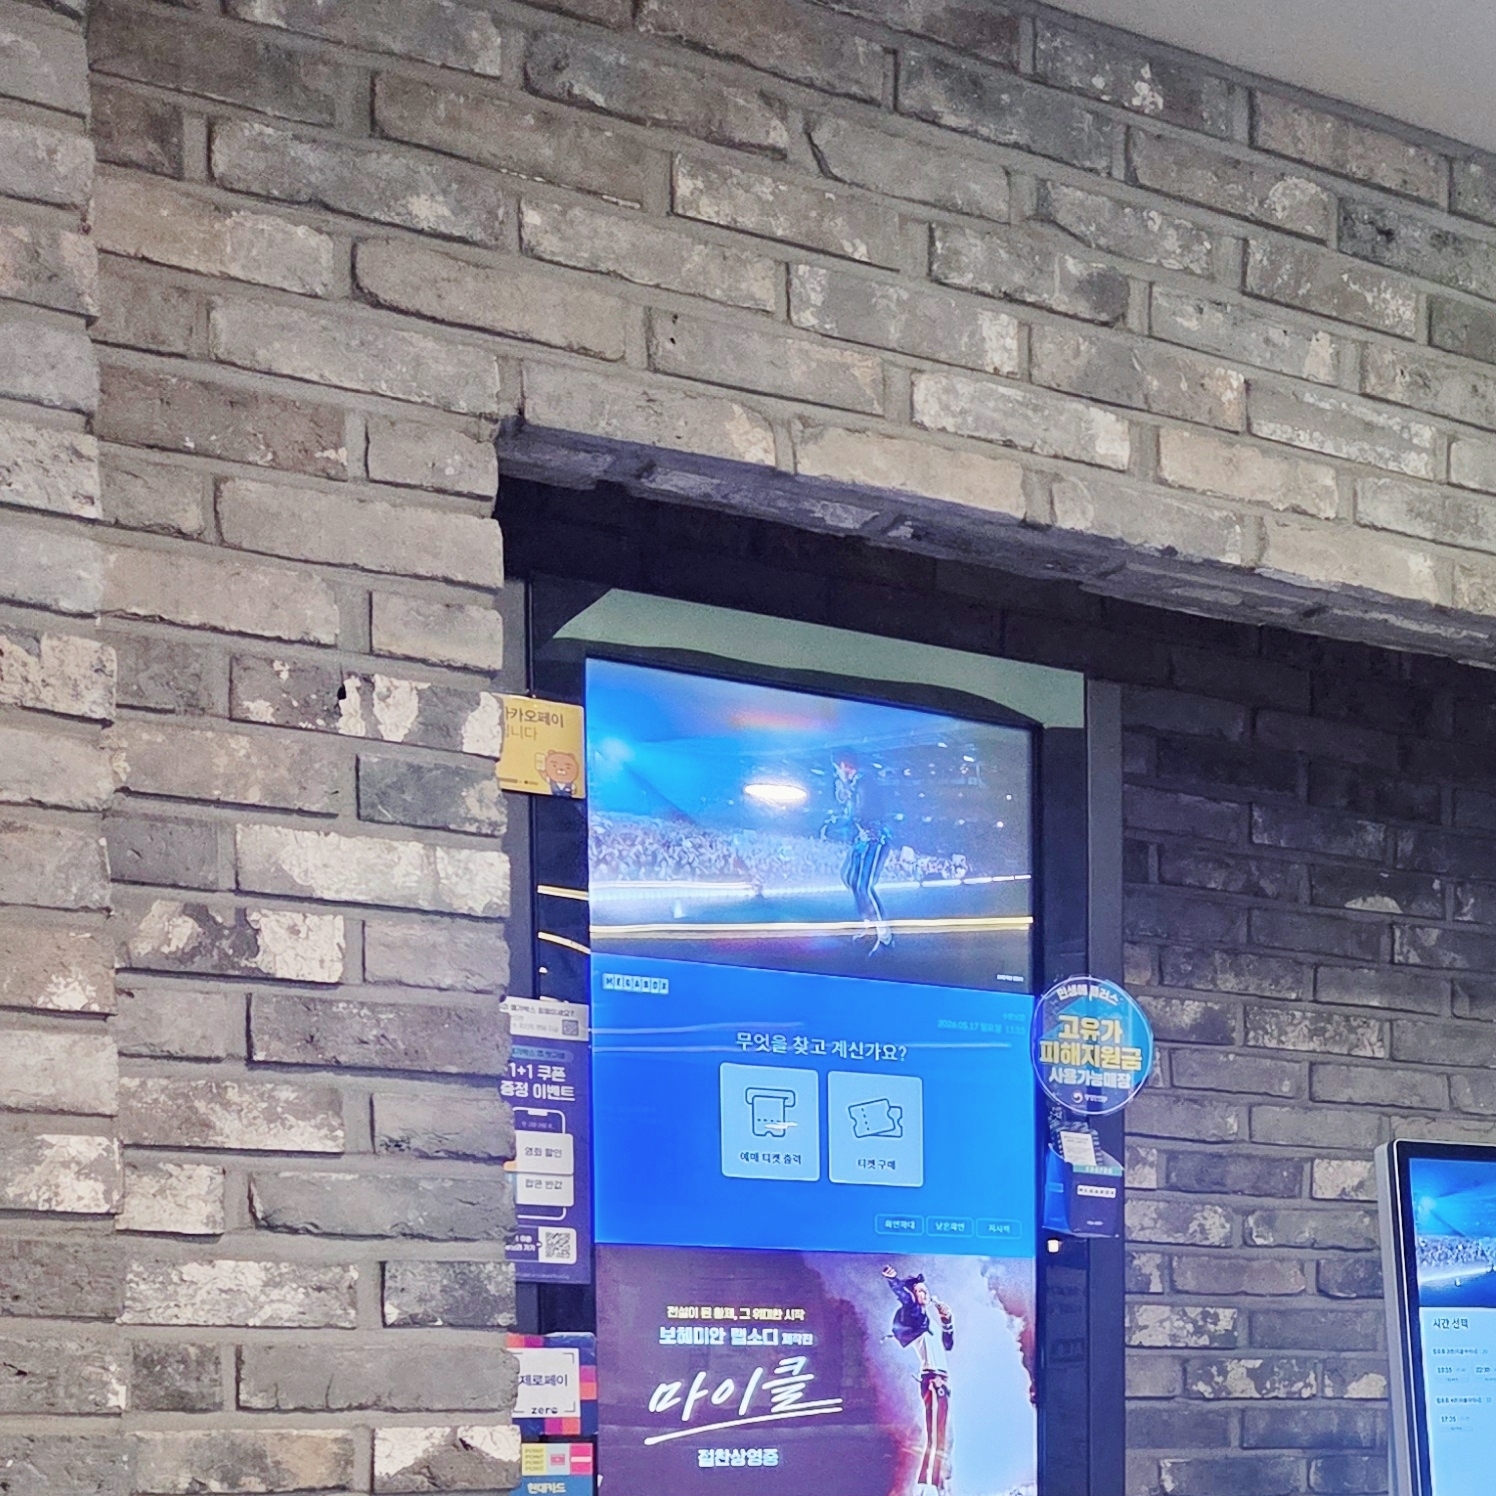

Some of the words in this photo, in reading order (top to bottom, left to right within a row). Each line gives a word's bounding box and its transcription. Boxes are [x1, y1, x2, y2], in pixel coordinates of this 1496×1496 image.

[604, 975, 668, 992] MEGABOX
[1058, 1014, 1124, 1044] 고유가
[736, 1031, 789, 1053] 무엇을
[792, 1036, 828, 1056] 찾고
[831, 1040, 908, 1062] 계신가요?
[1039, 1040, 1143, 1071] 피해지원금
[510, 1062, 534, 1080] 1+1
[538, 1064, 567, 1083] 쿠폰
[500, 1080, 529, 1098] 증정
[532, 1083, 576, 1102] 이벤트
[740, 1151, 760, 1163] 예매
[762, 1153, 781, 1165] 티켓
[783, 1154, 802, 1166] 출력
[857, 1158, 876, 1169] 티켓
[878, 1159, 897, 1170] 구매
[667, 1306, 699, 1319] 전설이
[739, 1307, 751, 1320] 그
[1432, 1318, 1450, 1330] 시간
[1451, 1317, 1469, 1330] 선택
[659, 1326, 727, 1345] 보헤미안
[730, 1327, 779, 1346] 랩소디
[518, 1373, 568, 1387] 제로페이
[648, 1355, 843, 1421] 마이클
